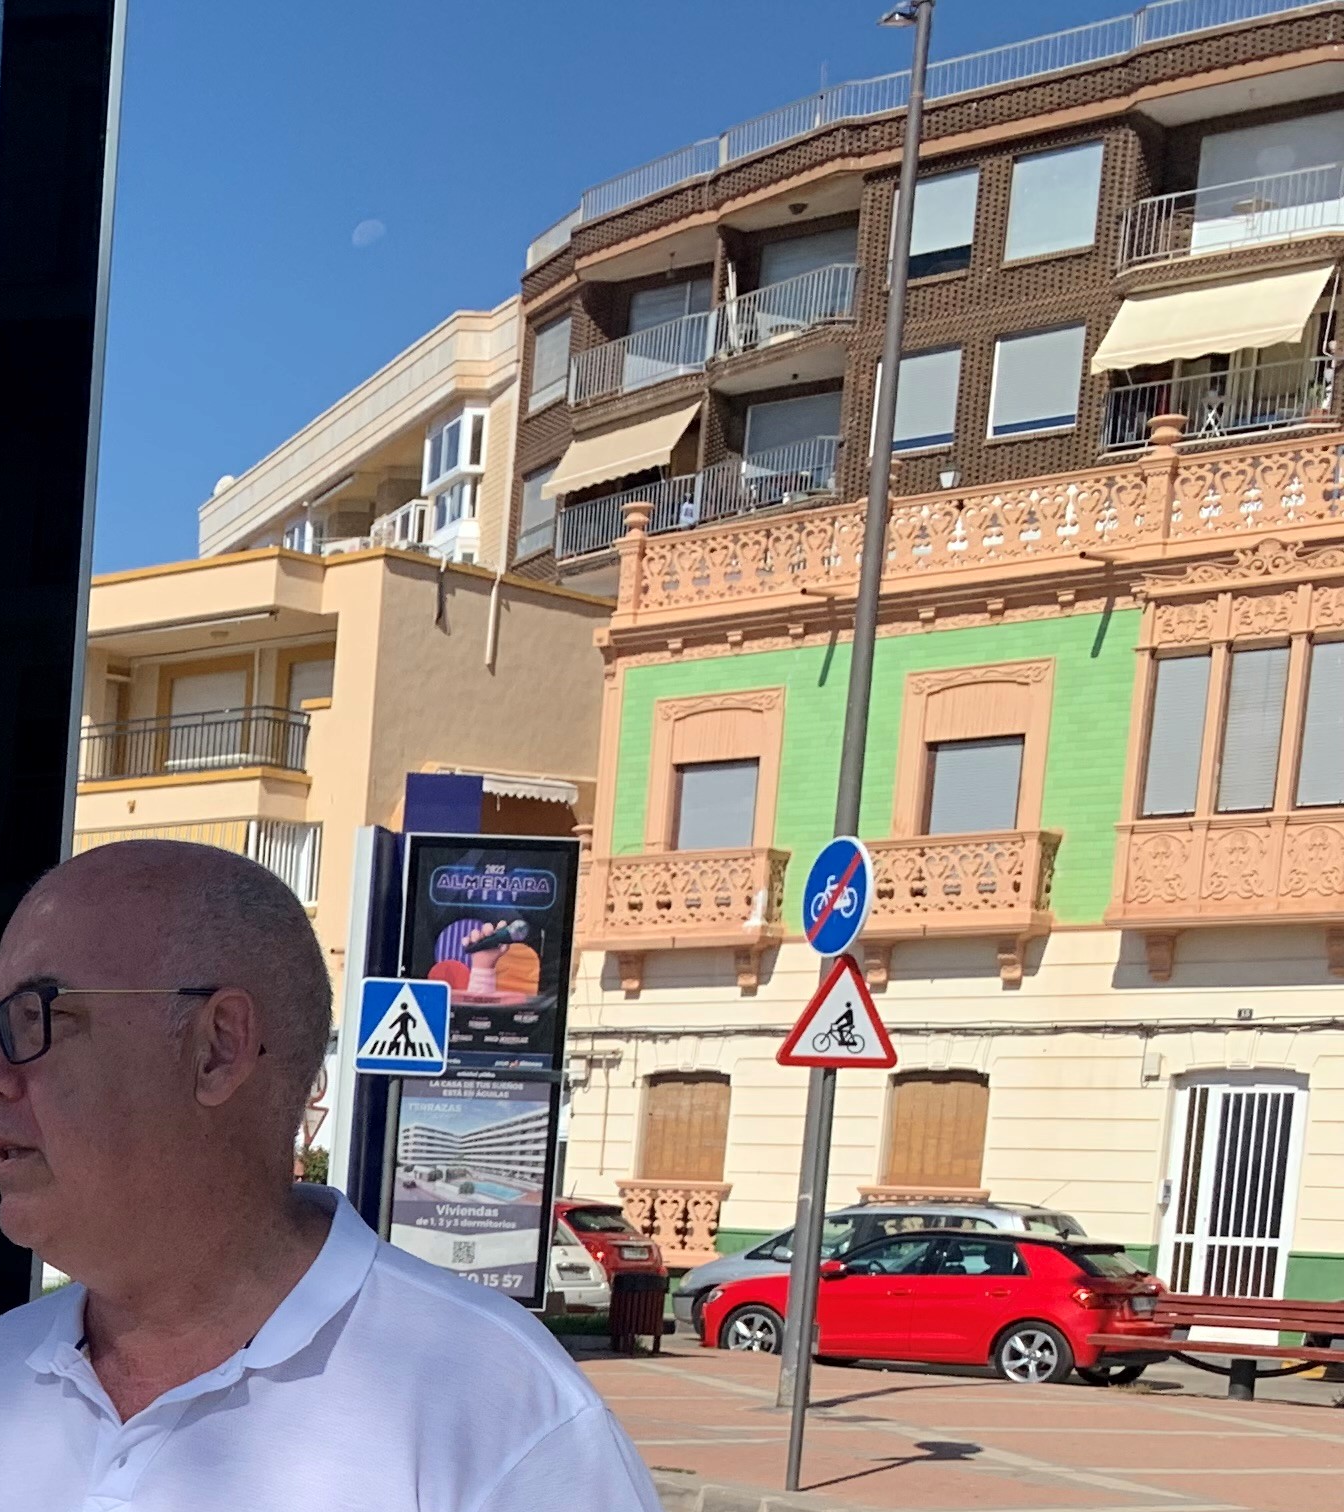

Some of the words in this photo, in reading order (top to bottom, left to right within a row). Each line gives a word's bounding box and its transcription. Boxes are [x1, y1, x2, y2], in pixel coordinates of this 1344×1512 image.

[437, 874, 550, 893] ALMENARA
[436, 1204, 499, 1218] Viviendas
[502, 1274, 523, 1288] 57
